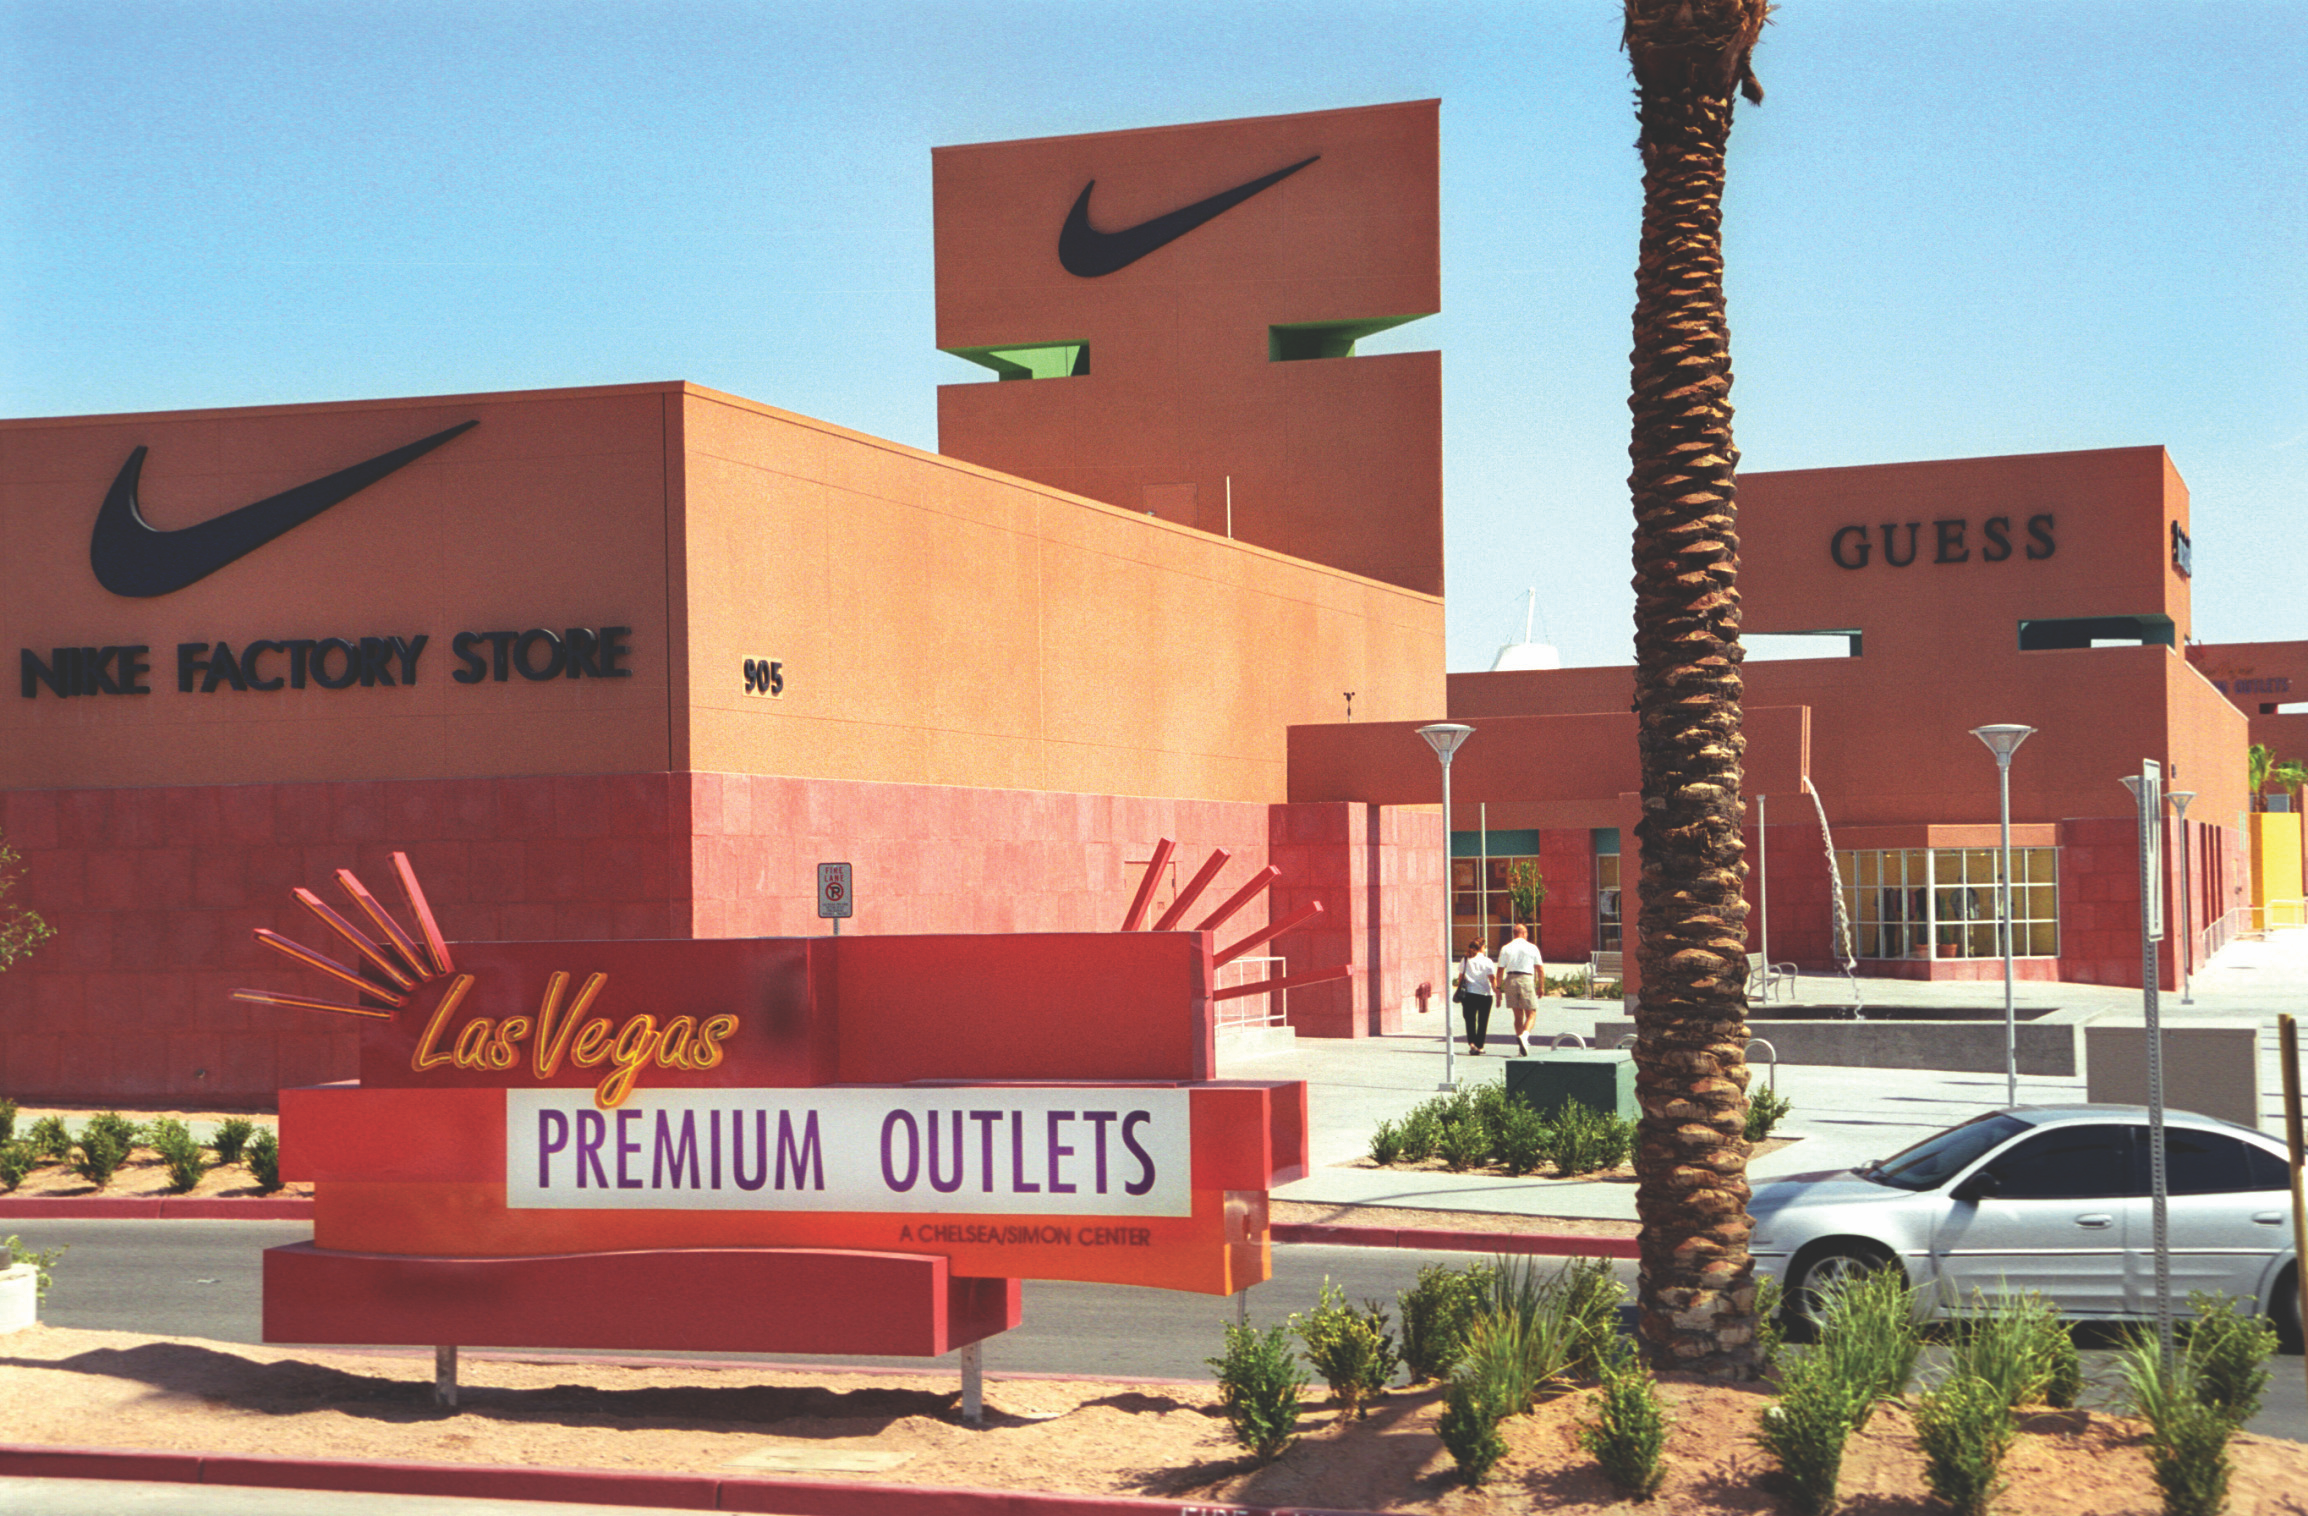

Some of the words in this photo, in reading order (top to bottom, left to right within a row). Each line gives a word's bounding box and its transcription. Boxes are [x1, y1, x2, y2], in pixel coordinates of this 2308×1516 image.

[1830, 514, 2056, 570] GUESS
[20, 645, 150, 698] NIKE
[177, 634, 429, 692] FACTORY
[452, 626, 633, 684] STORE
[743, 658, 784, 697] 905
[824, 874, 844, 882] LANE
[825, 866, 844, 874] FIRE
[411, 974, 533, 1072] Las
[532, 970, 739, 1110] Vegas
[538, 1108, 825, 1190] PREMIUM
[880, 1108, 1156, 1195] OUTLETS
[899, 1224, 914, 1242] A
[917, 1224, 1072, 1246] CHELSEA/SIMON
[1077, 1227, 1152, 1247] CENTER
